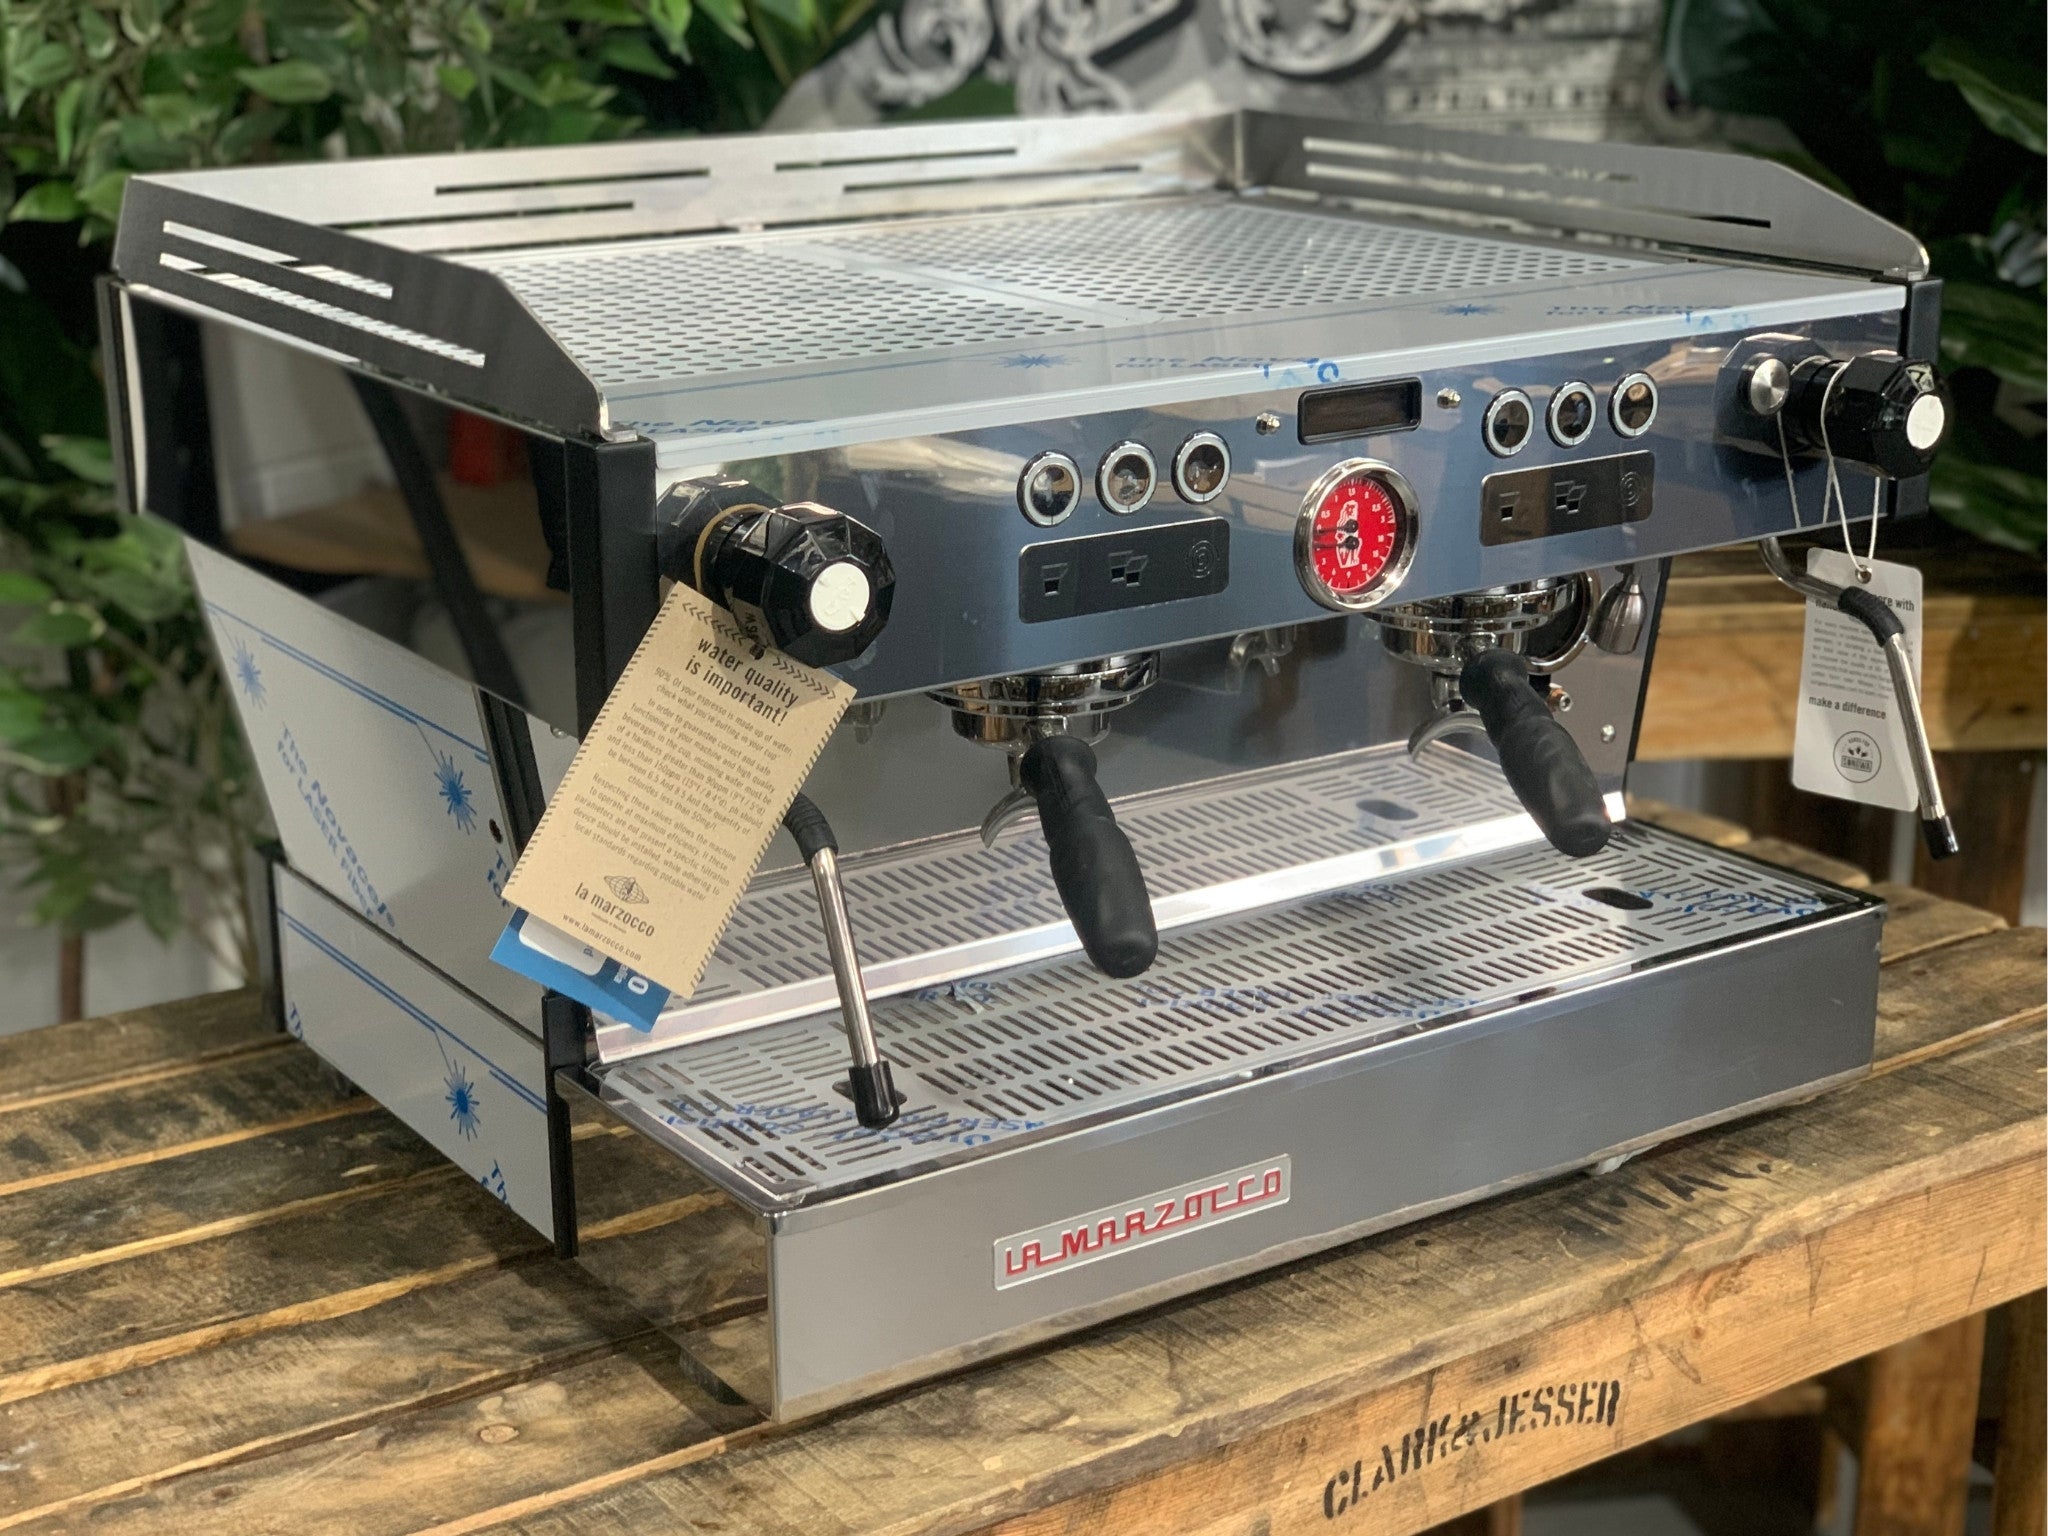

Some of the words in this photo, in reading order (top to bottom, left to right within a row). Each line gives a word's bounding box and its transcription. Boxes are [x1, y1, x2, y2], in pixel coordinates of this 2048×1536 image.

[1895, 597, 1915, 612] with
[696, 636, 744, 673] water
[742, 663, 800, 710] quality
[653, 666, 672, 682] 90%
[679, 684, 697, 699] your
[695, 693, 727, 717] espresso
[734, 714, 755, 731] made
[684, 654, 703, 675] is
[700, 665, 788, 729] important!
[1808, 694, 1833, 710] make
[1842, 701, 1887, 720] difference
[676, 695, 695, 711] what
[746, 739, 763, 753] your
[606, 732, 622, 746] and
[635, 749, 654, 765] than
[665, 737, 679, 750] the
[676, 731, 693, 745] your
[721, 756, 737, 769] and
[741, 753, 756, 766] and
[688, 765, 706, 780] than
[700, 802, 714, 814] the
[695, 832, 709, 845] the
[574, 882, 591, 900] la
[589, 893, 656, 937] marzocco
[561, 913, 642, 961] www.lamarzocco.com
[1005, 1246, 1042, 1277] LA
